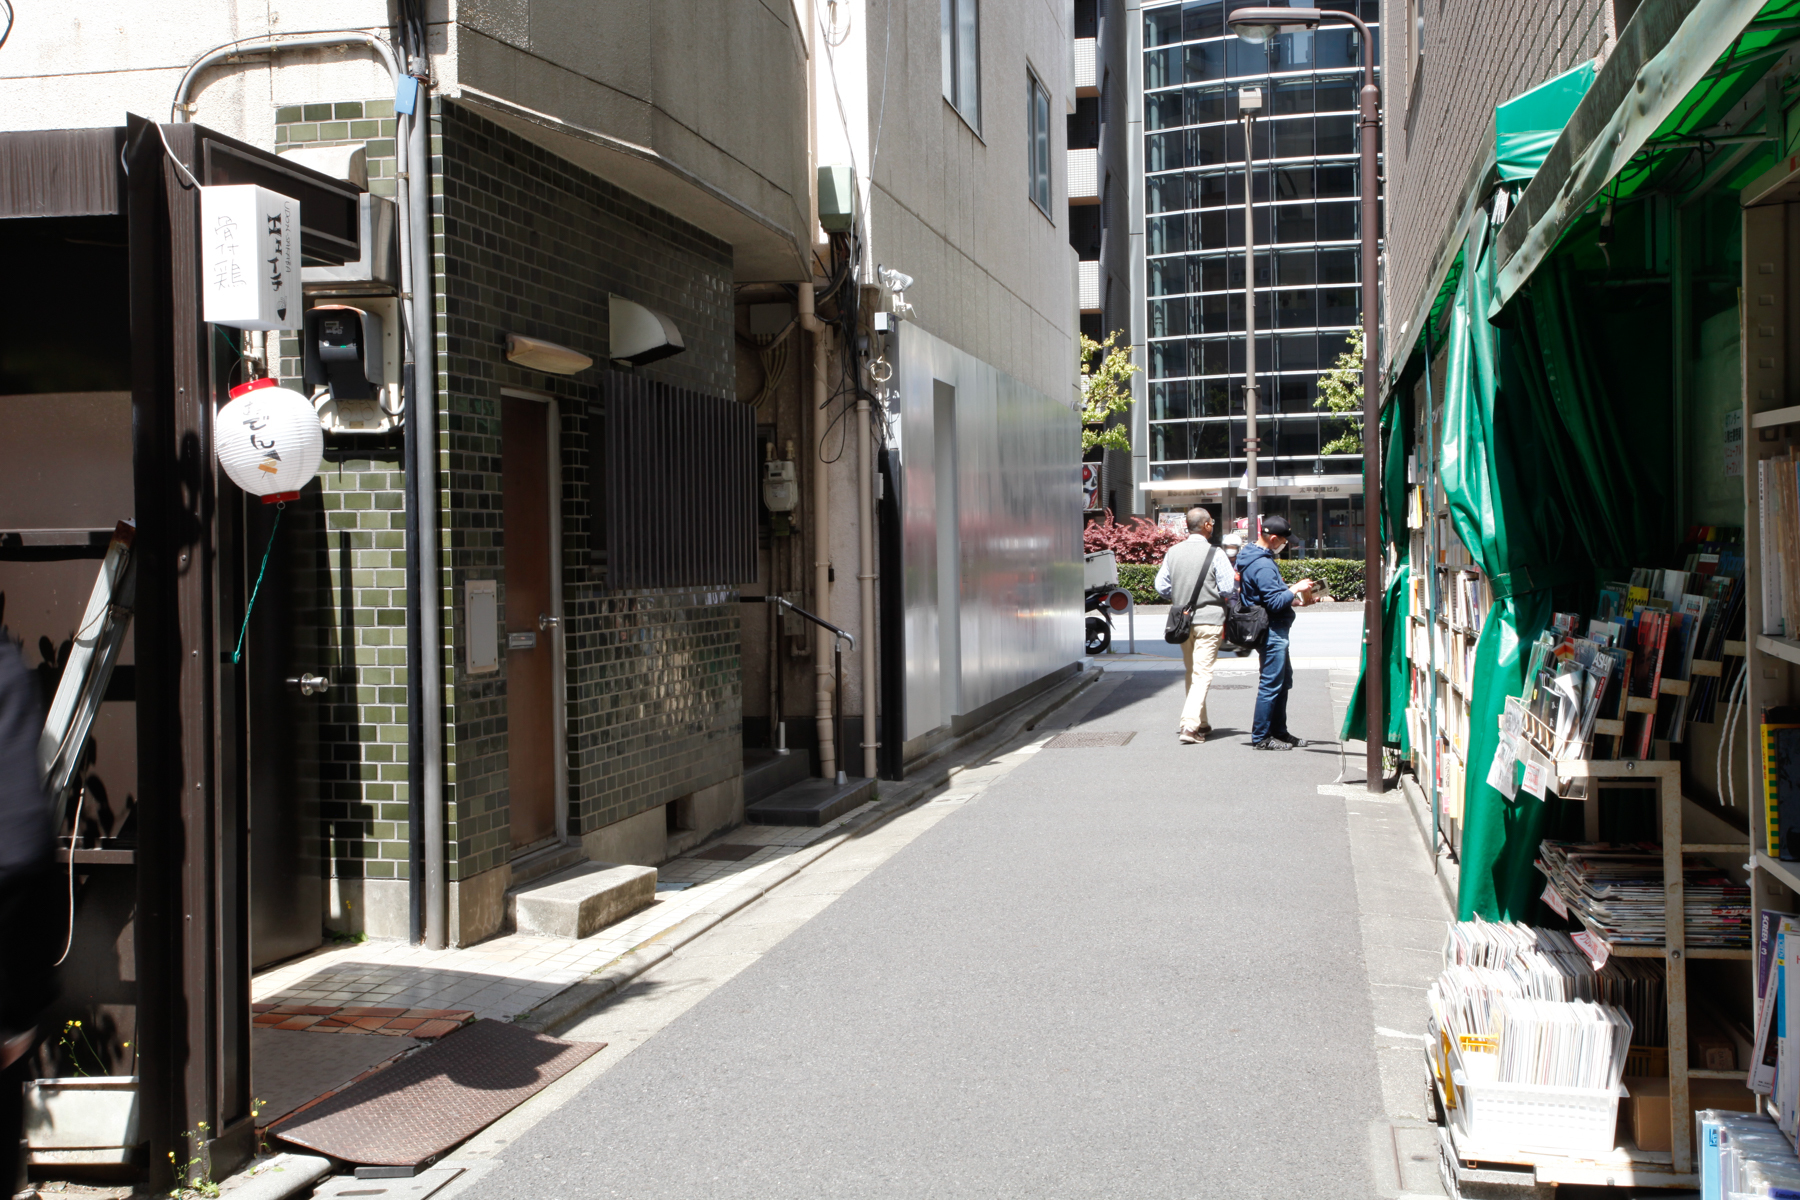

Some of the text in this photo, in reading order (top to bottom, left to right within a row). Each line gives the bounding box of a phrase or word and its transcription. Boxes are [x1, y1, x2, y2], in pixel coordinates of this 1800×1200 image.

[214, 215, 247, 291] 骨付鶏
[1761, 914, 1770, 943] SCREEN
[1761, 947, 1767, 956] 3
